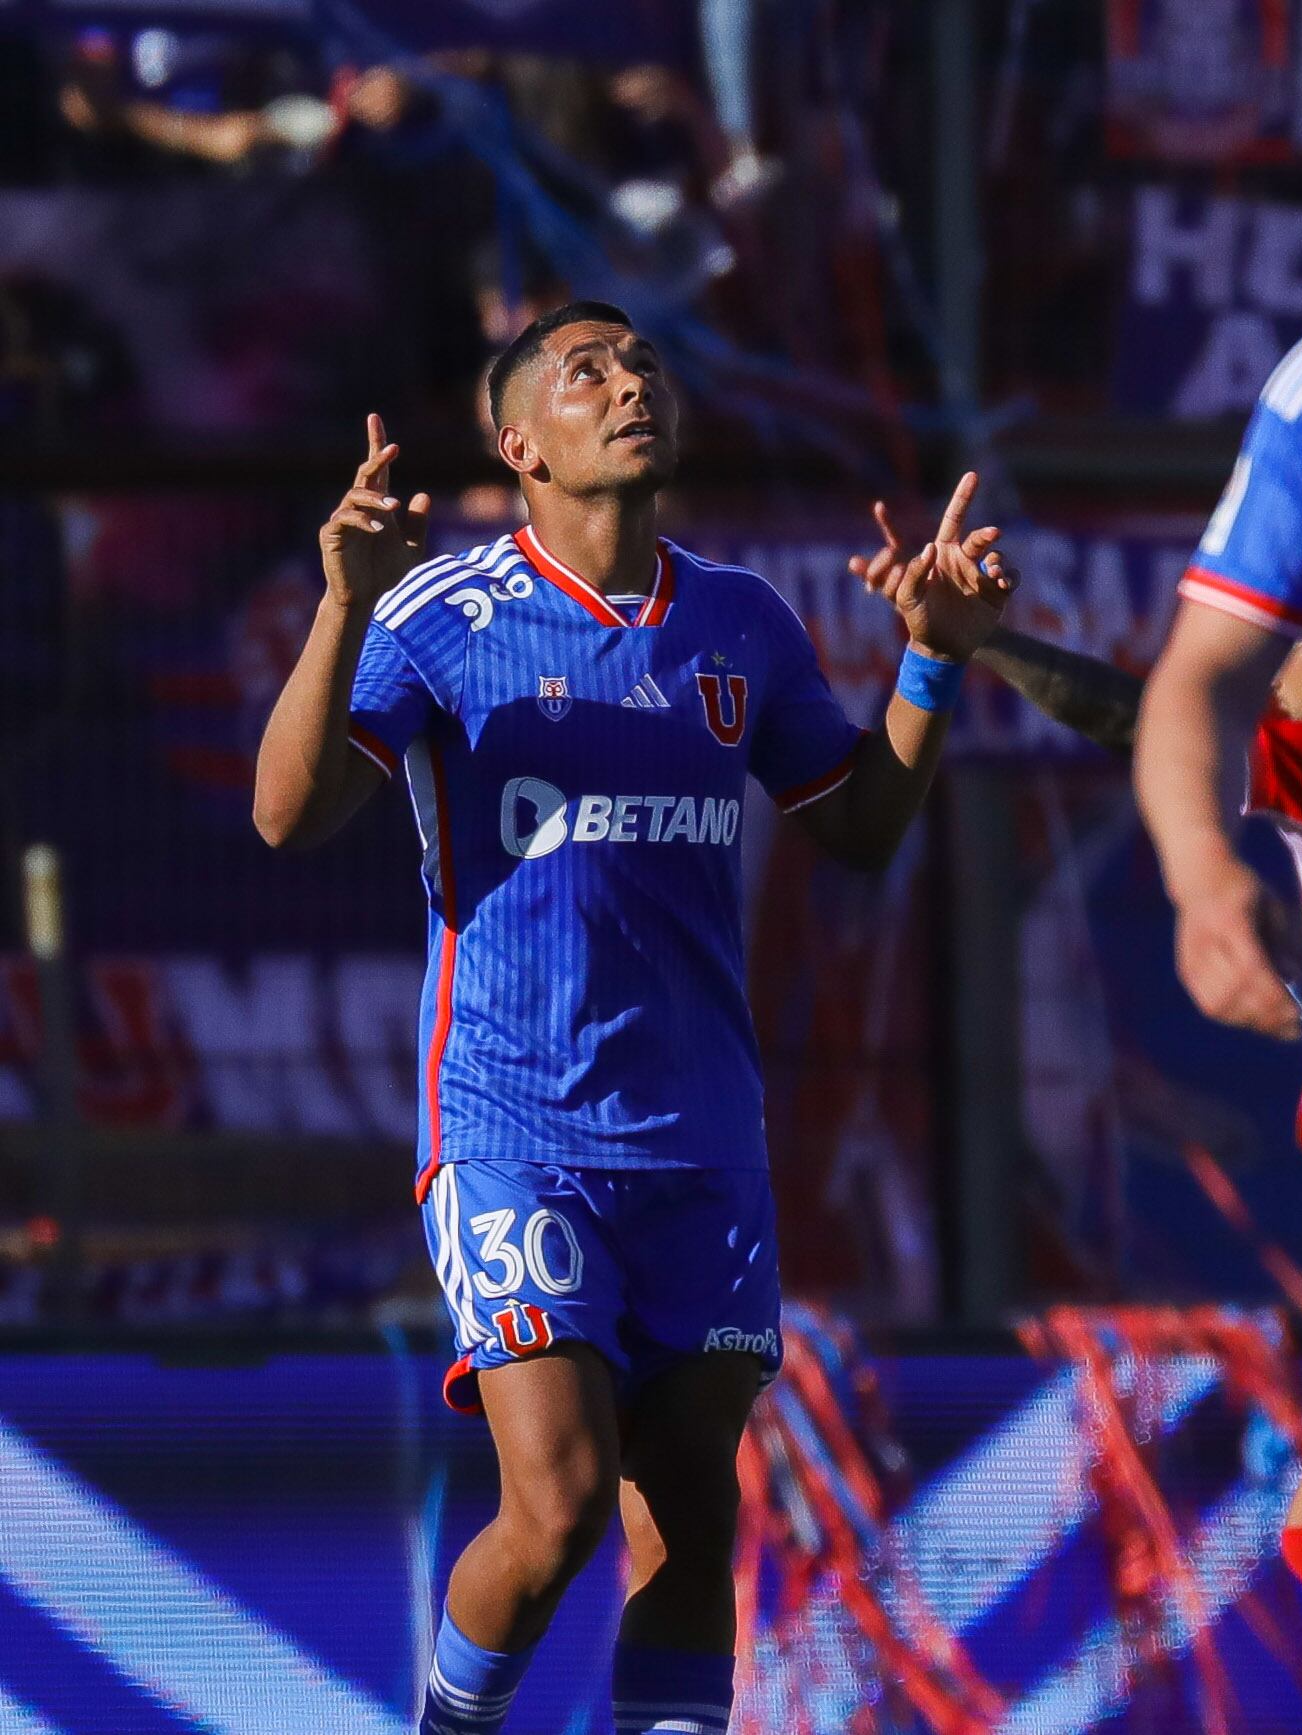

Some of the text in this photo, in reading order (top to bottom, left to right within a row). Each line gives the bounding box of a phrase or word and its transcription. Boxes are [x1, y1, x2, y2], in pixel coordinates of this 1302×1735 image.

[695, 673, 749, 748] U
[571, 794, 740, 847] BETANO
[469, 1207, 585, 1299] 30
[490, 1303, 554, 1358] U
